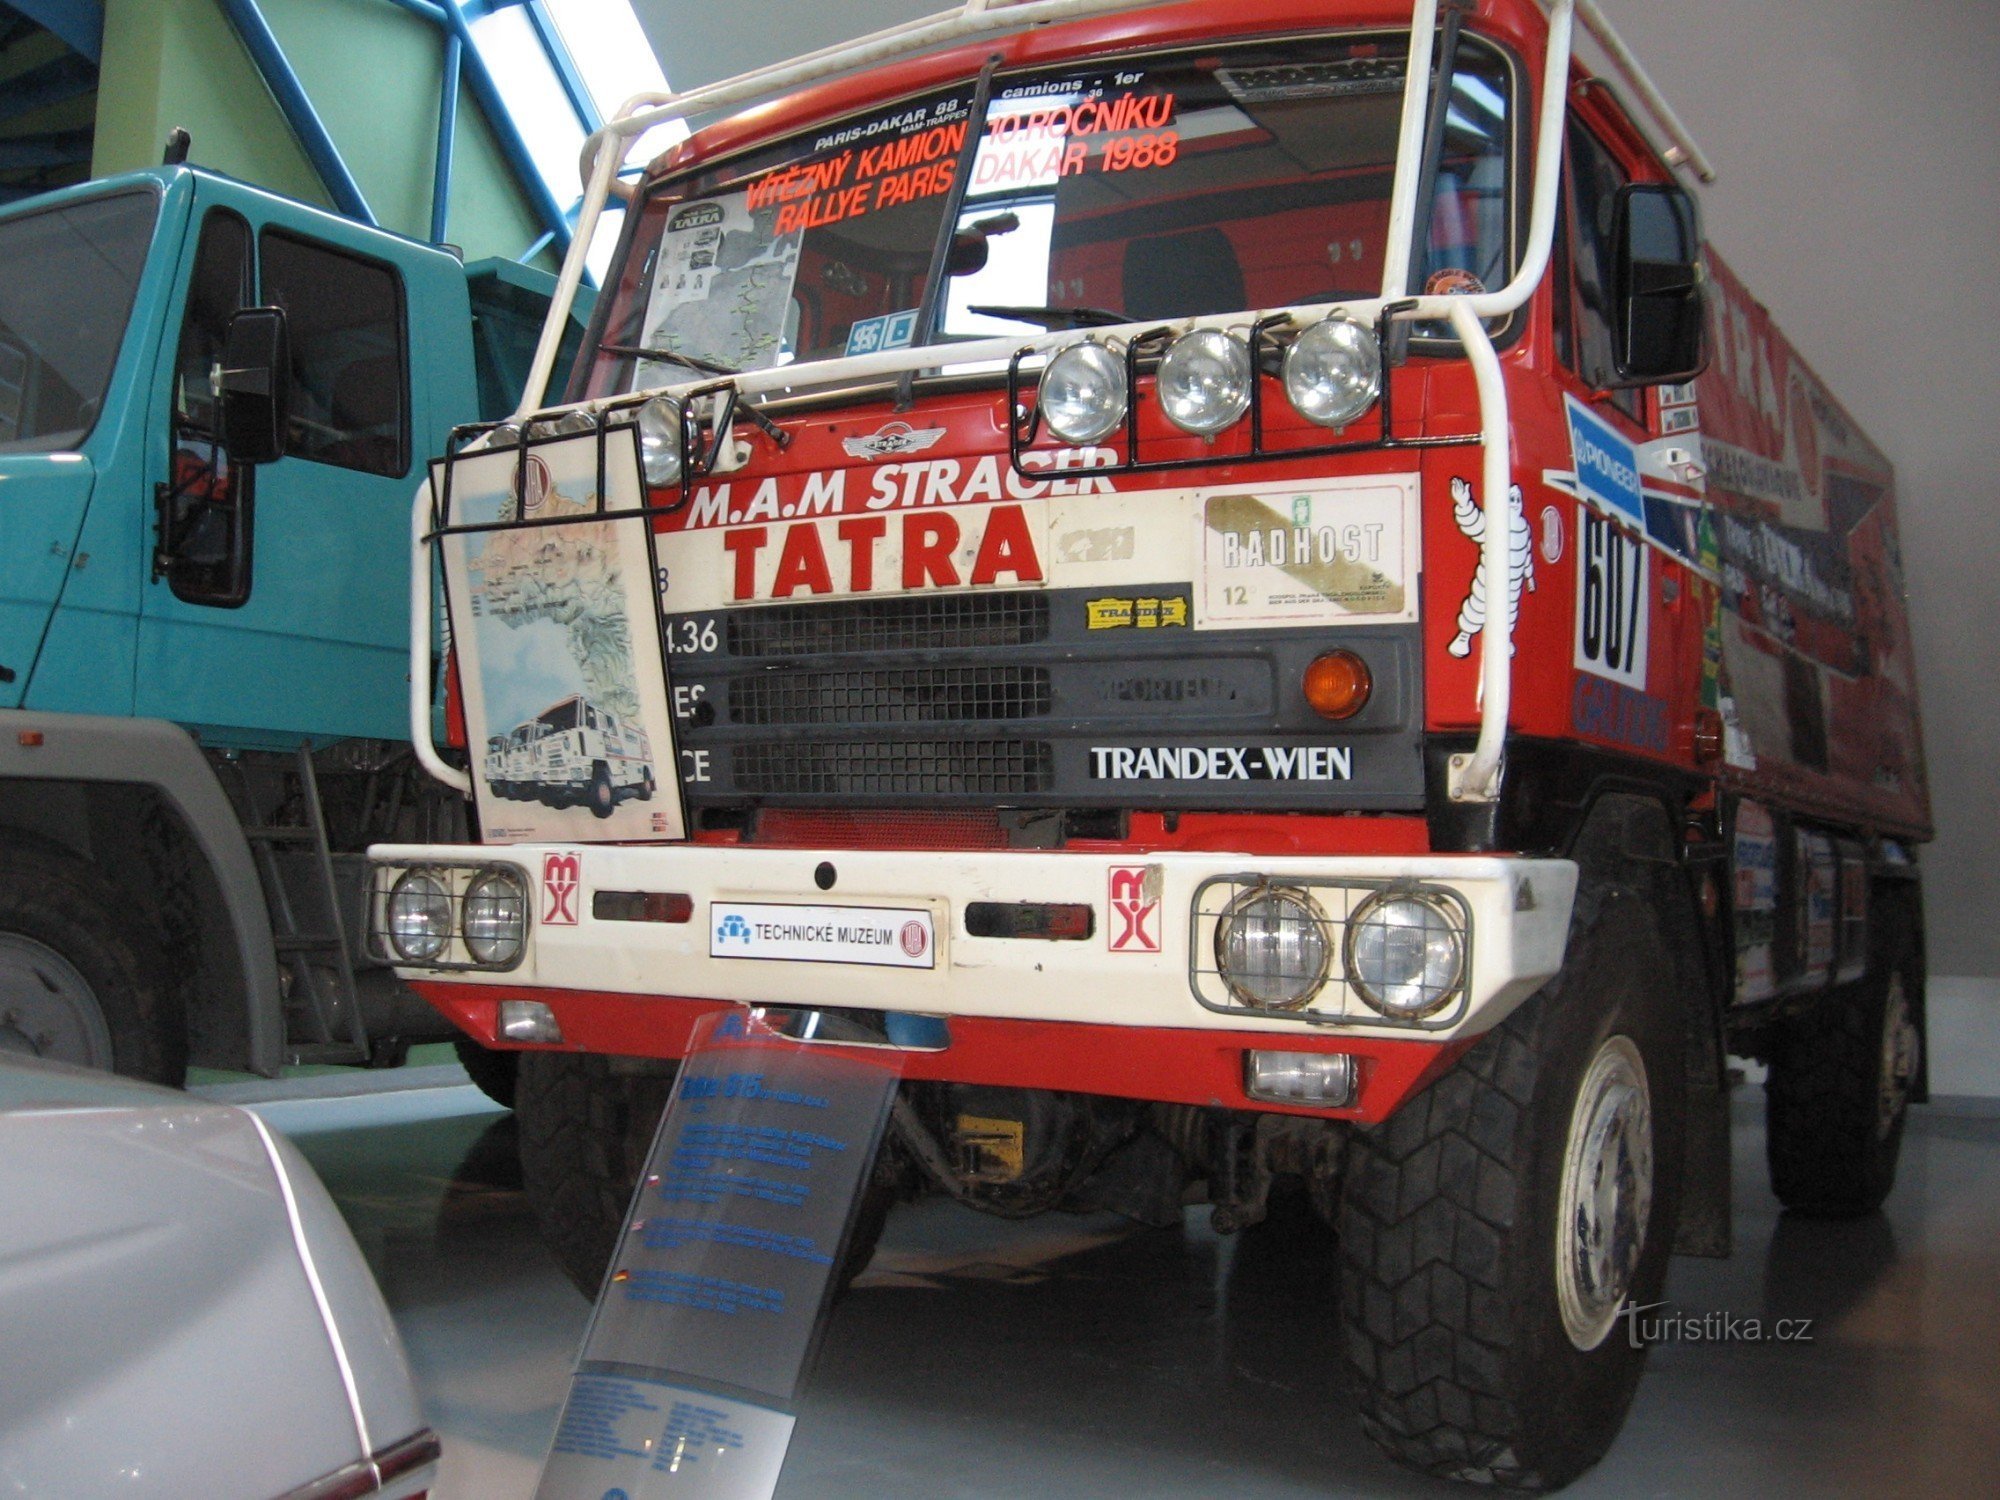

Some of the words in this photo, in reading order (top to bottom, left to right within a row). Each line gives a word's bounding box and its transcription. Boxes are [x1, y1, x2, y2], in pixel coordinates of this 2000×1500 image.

[814, 108, 927, 151] PARIS-DAKAR
[934, 98, 958, 115] 88
[1001, 78, 1083, 99] camions
[1114, 71, 1144, 86] 1er
[855, 120, 969, 180] KAMION
[986, 92, 1175, 146] 10.ROČNÍKU
[900, 108, 969, 134] MAM-TRAPPES
[773, 181, 873, 237] RALLYE
[877, 158, 957, 210] PARIS
[975, 141, 1089, 186] DAKAR
[1101, 130, 1180, 172] 1988
[684, 469, 846, 529] M.A.M
[1585, 440, 1639, 494] PIONEER
[723, 503, 1043, 600] TATRA
[1583, 497, 1641, 673] 607
[1091, 746, 1351, 780] TRANDEX-WIEN
[755, 921, 834, 943] TECHNICKÉ
[837, 926, 893, 946] MUZEUM
